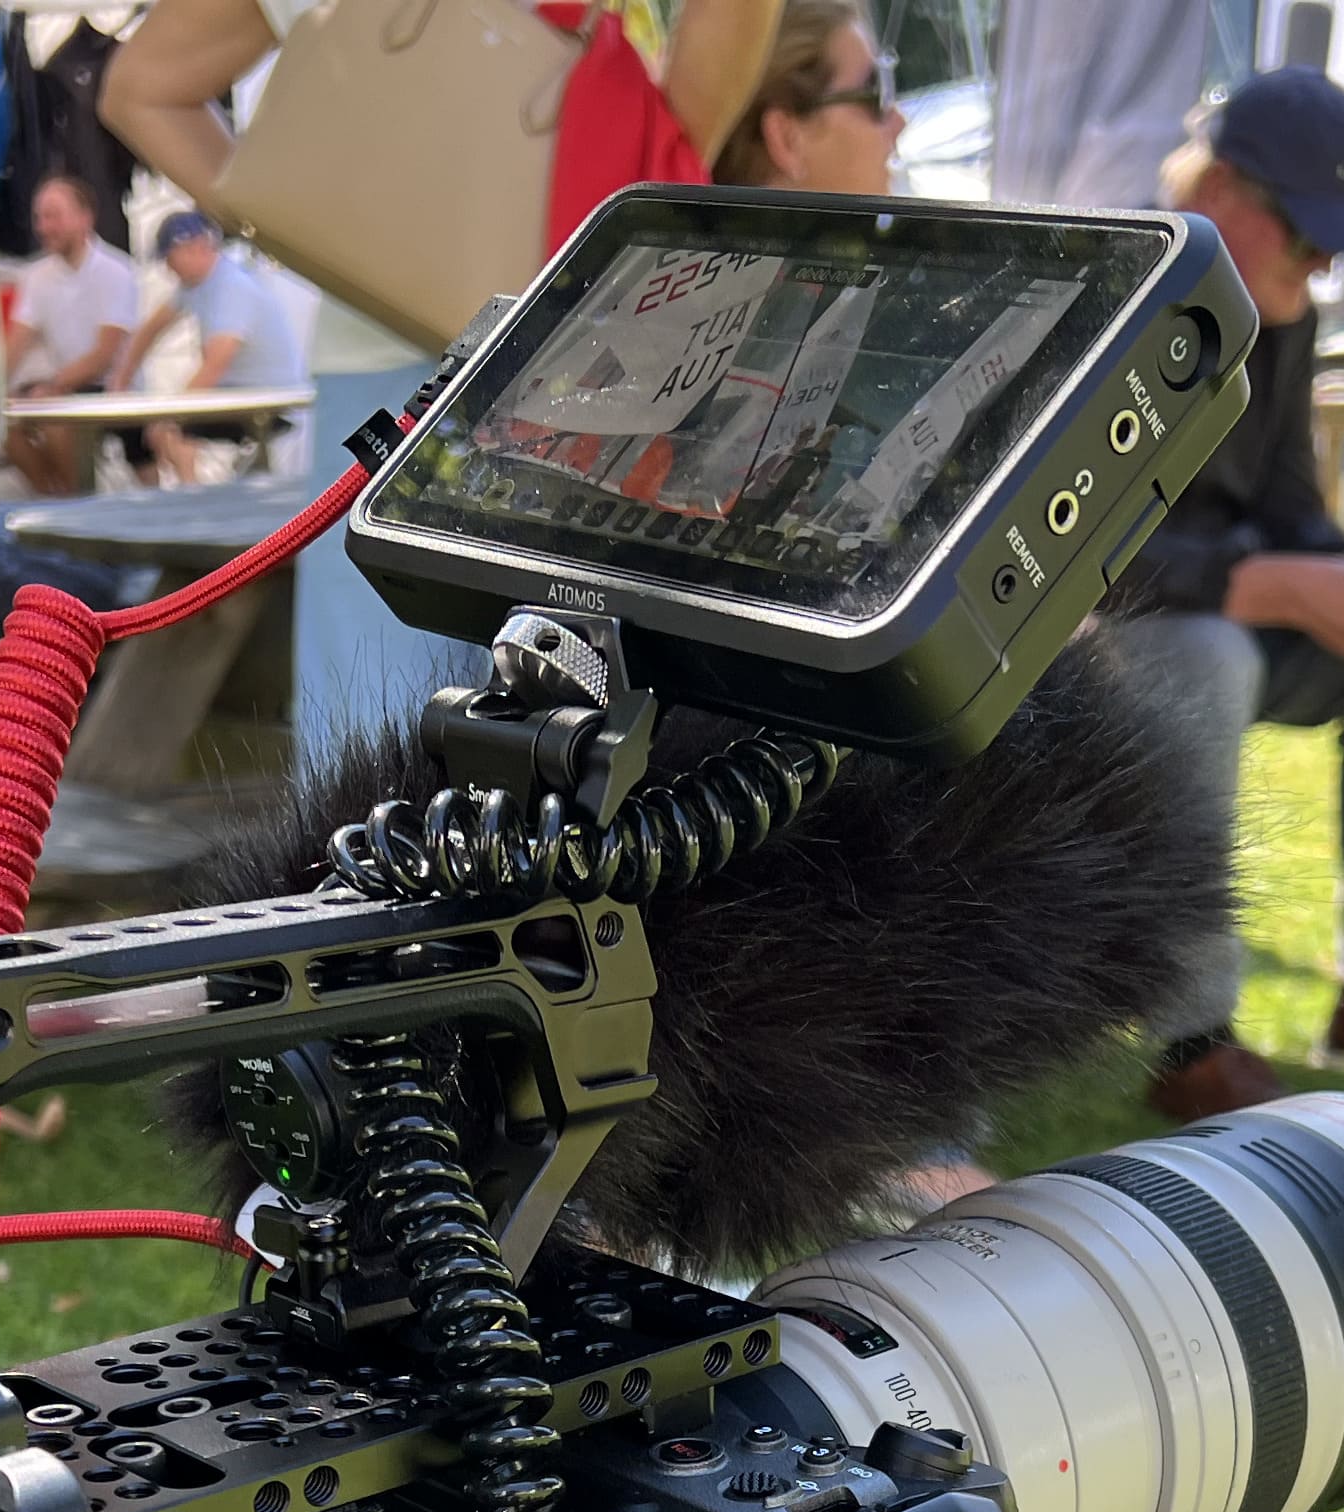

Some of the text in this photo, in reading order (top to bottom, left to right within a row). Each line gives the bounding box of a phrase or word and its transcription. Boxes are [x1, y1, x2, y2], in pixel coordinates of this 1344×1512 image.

[651, 345, 734, 402] AUT
[1124, 368, 1166, 440] MIC/LINE
[1006, 525, 1046, 588] REMOTE
[548, 583, 606, 611] ATOMOS
[846, 1467, 873, 1478] ISO
